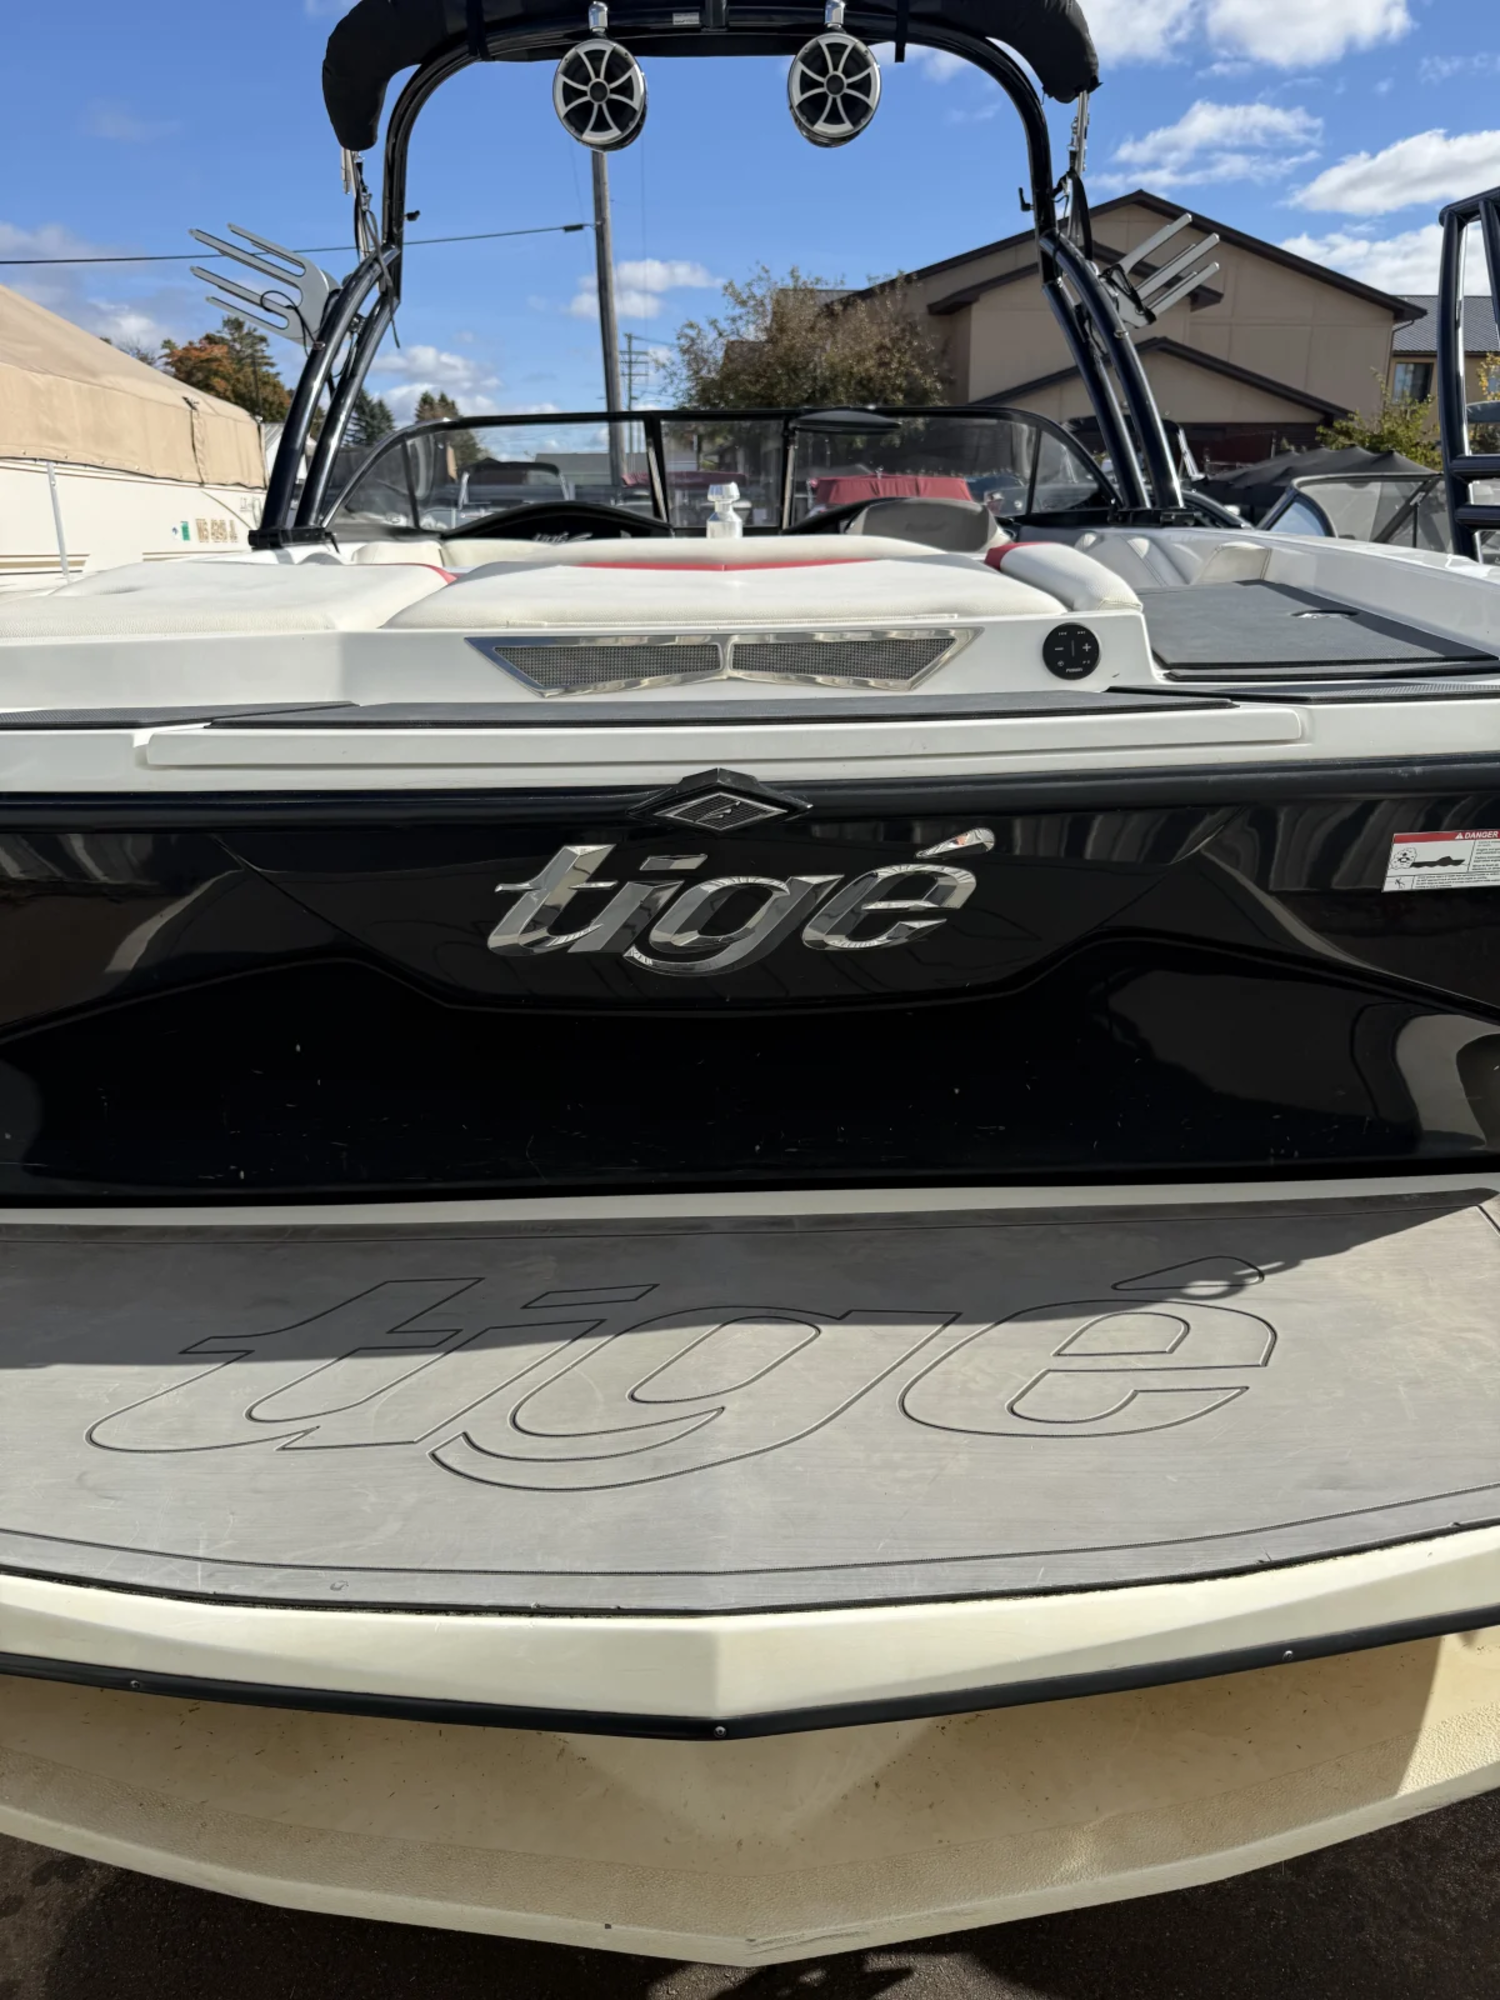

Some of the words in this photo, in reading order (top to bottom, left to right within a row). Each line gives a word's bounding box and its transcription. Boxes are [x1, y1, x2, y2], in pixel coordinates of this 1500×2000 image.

[487, 828, 995, 976] tigé
[1464, 830, 1499, 840] DANGER
[85, 1255, 1278, 1491] tigé
